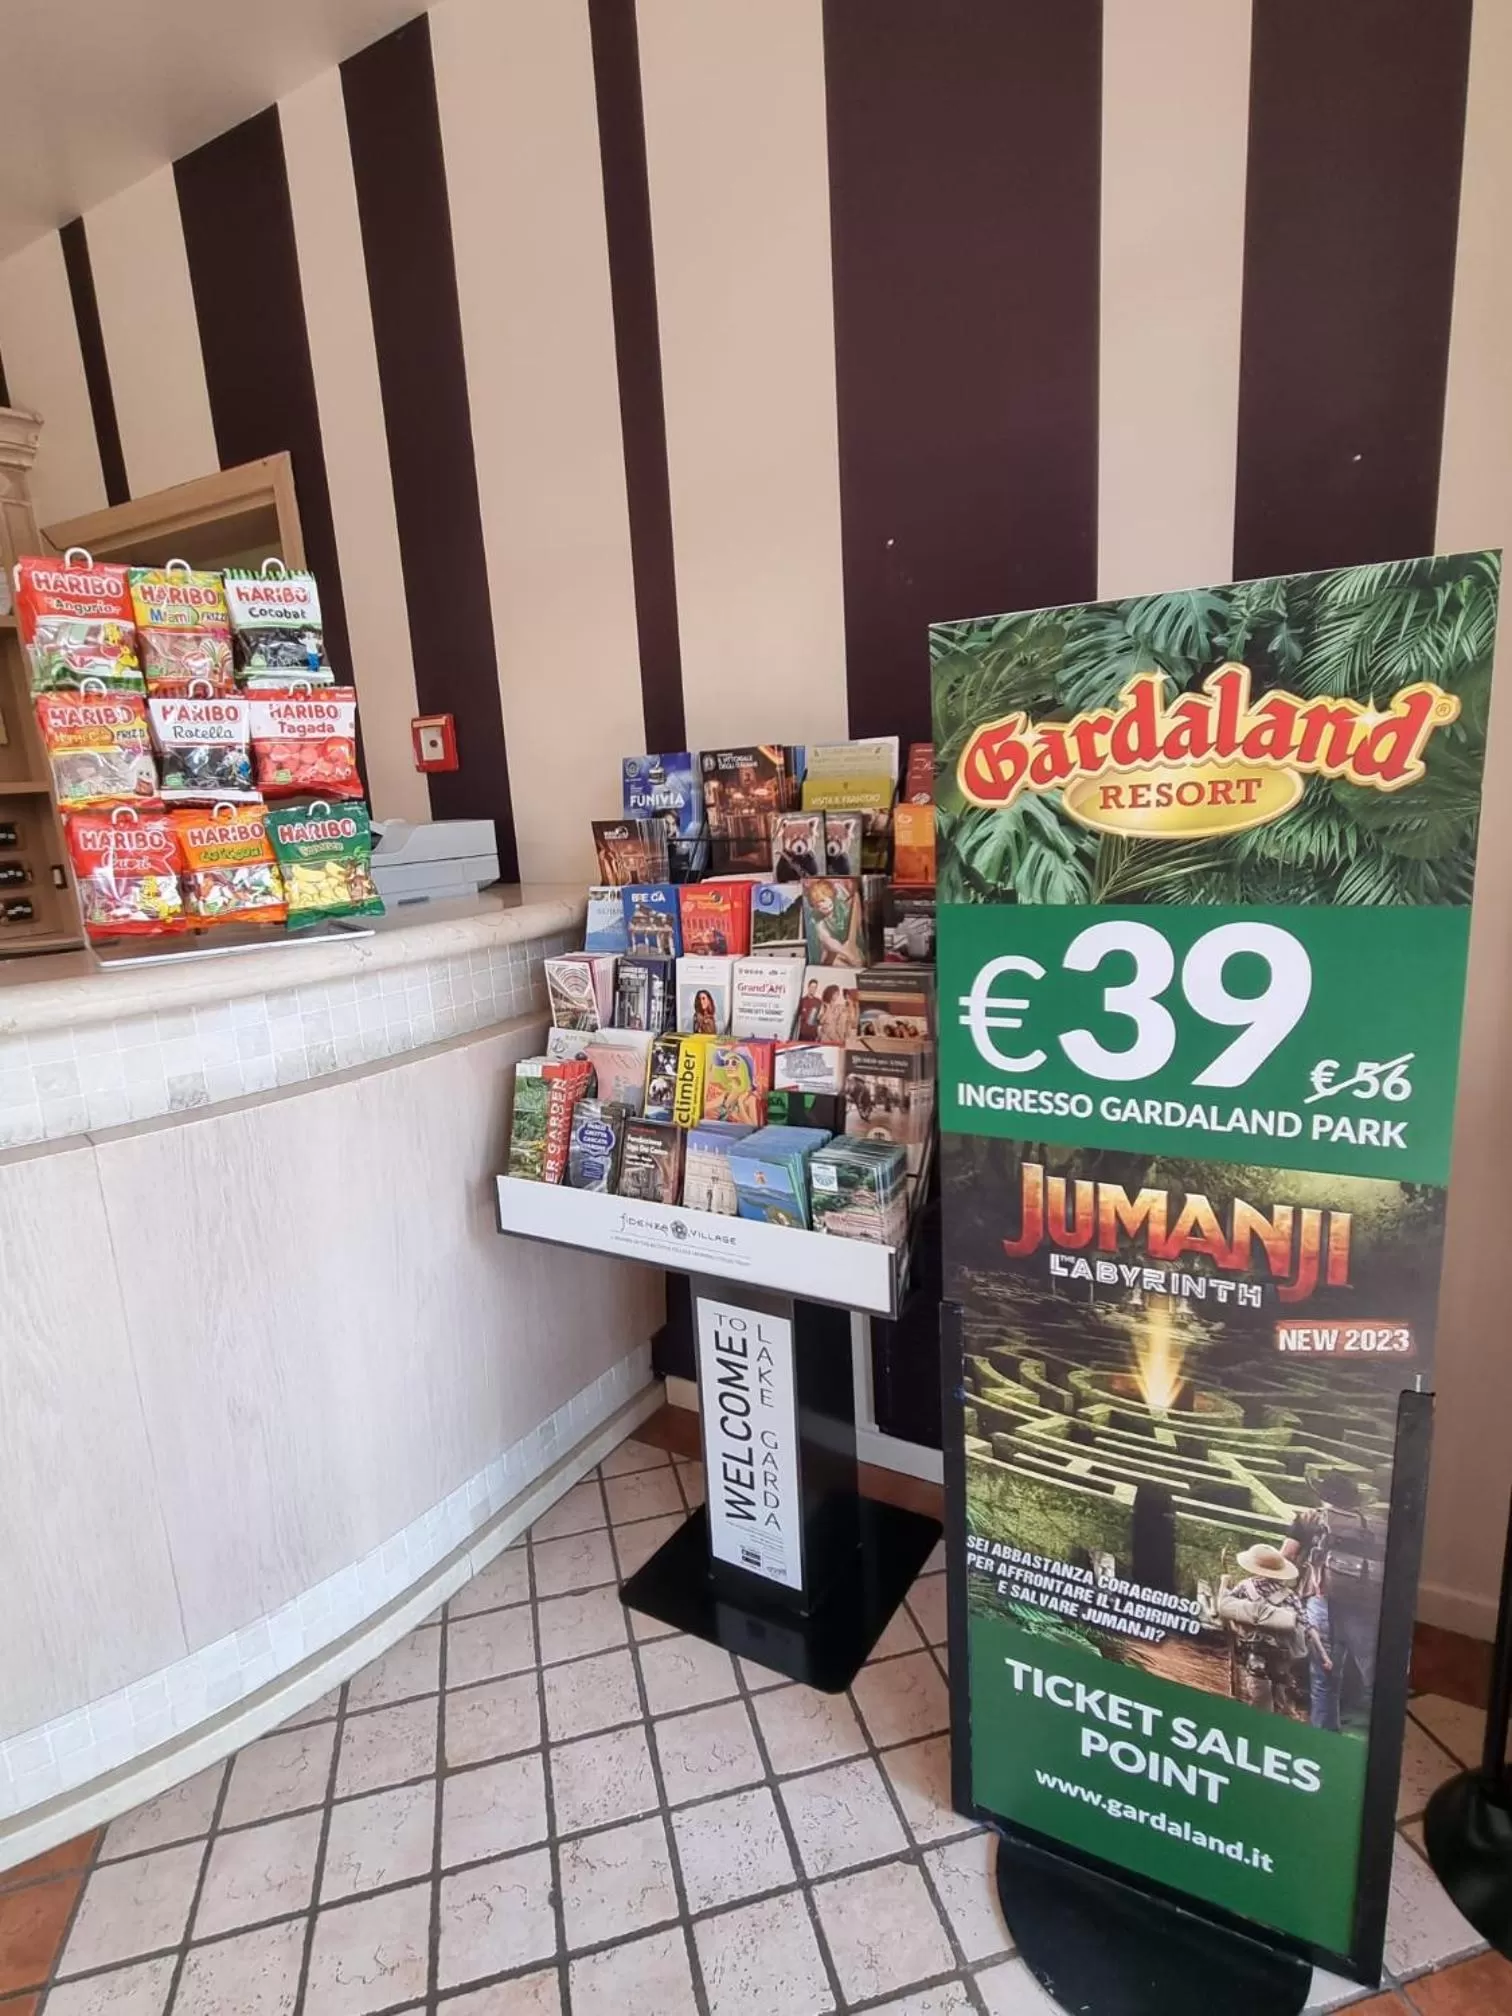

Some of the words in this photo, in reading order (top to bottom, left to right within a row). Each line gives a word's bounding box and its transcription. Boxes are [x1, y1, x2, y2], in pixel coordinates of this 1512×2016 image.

[32, 571, 123, 597] HARIBO
[140, 584, 219, 606] HARIBO
[235, 586, 309, 604] HARIBO
[54, 598, 113, 616] Anguria
[248, 606, 307, 619] Cocobat
[49, 705, 135, 727] HARIBO
[161, 704, 239, 722] HARIBO
[268, 703, 339, 719] HARIBO
[172, 725, 234, 739] Rotella
[278, 721, 335, 737] Tagada
[963, 668, 1437, 800] Gardaland
[629, 794, 686, 808] FUNIVIA
[1098, 777, 1263, 812] RESORT
[81, 830, 164, 850] HARIBO
[188, 823, 265, 846] HARIBO
[278, 818, 356, 844] HARIBO
[675, 1050, 697, 1124] climber
[549, 1078, 567, 1156] GARDEN
[957, 1083, 1093, 1118] INGRESSO
[1100, 1097, 1302, 1138] GARDALAND
[1312, 1115, 1408, 1149] PARK
[690, 1229, 737, 1245] VILLAGE
[1002, 1161, 1354, 1304] JUMANJI
[1059, 1254, 1076, 1263] THE
[1048, 1254, 1263, 1308] LABYRINTH
[714, 1312, 747, 1331] TO
[1278, 1328, 1340, 1352] NEW
[1343, 1328, 1410, 1352] 2023
[756, 1323, 774, 1408] LAKE
[715, 1330, 757, 1522] WELCOME
[760, 1431, 781, 1531] GARDA
[966, 1535, 989, 1553] SEI
[991, 1542, 1094, 1585] ABBASTANZA
[1097, 1576, 1202, 1616] CORAGGIOSO
[966, 1552, 994, 1572] PER
[996, 1561, 1094, 1604] AFFRONTARE
[1096, 1593, 1110, 1609] IL
[1113, 1598, 1202, 1636] LABIRINTO
[997, 1581, 1008, 1595] E
[1010, 1585, 1078, 1618] SALVARE
[1081, 1605, 1166, 1643] JUMANJI?
[1004, 1657, 1163, 1737] TICKET
[1169, 1716, 1322, 1793] SALES
[1081, 1727, 1230, 1804] POINT
[1035, 1768, 1275, 1875] www.gardaland.it
